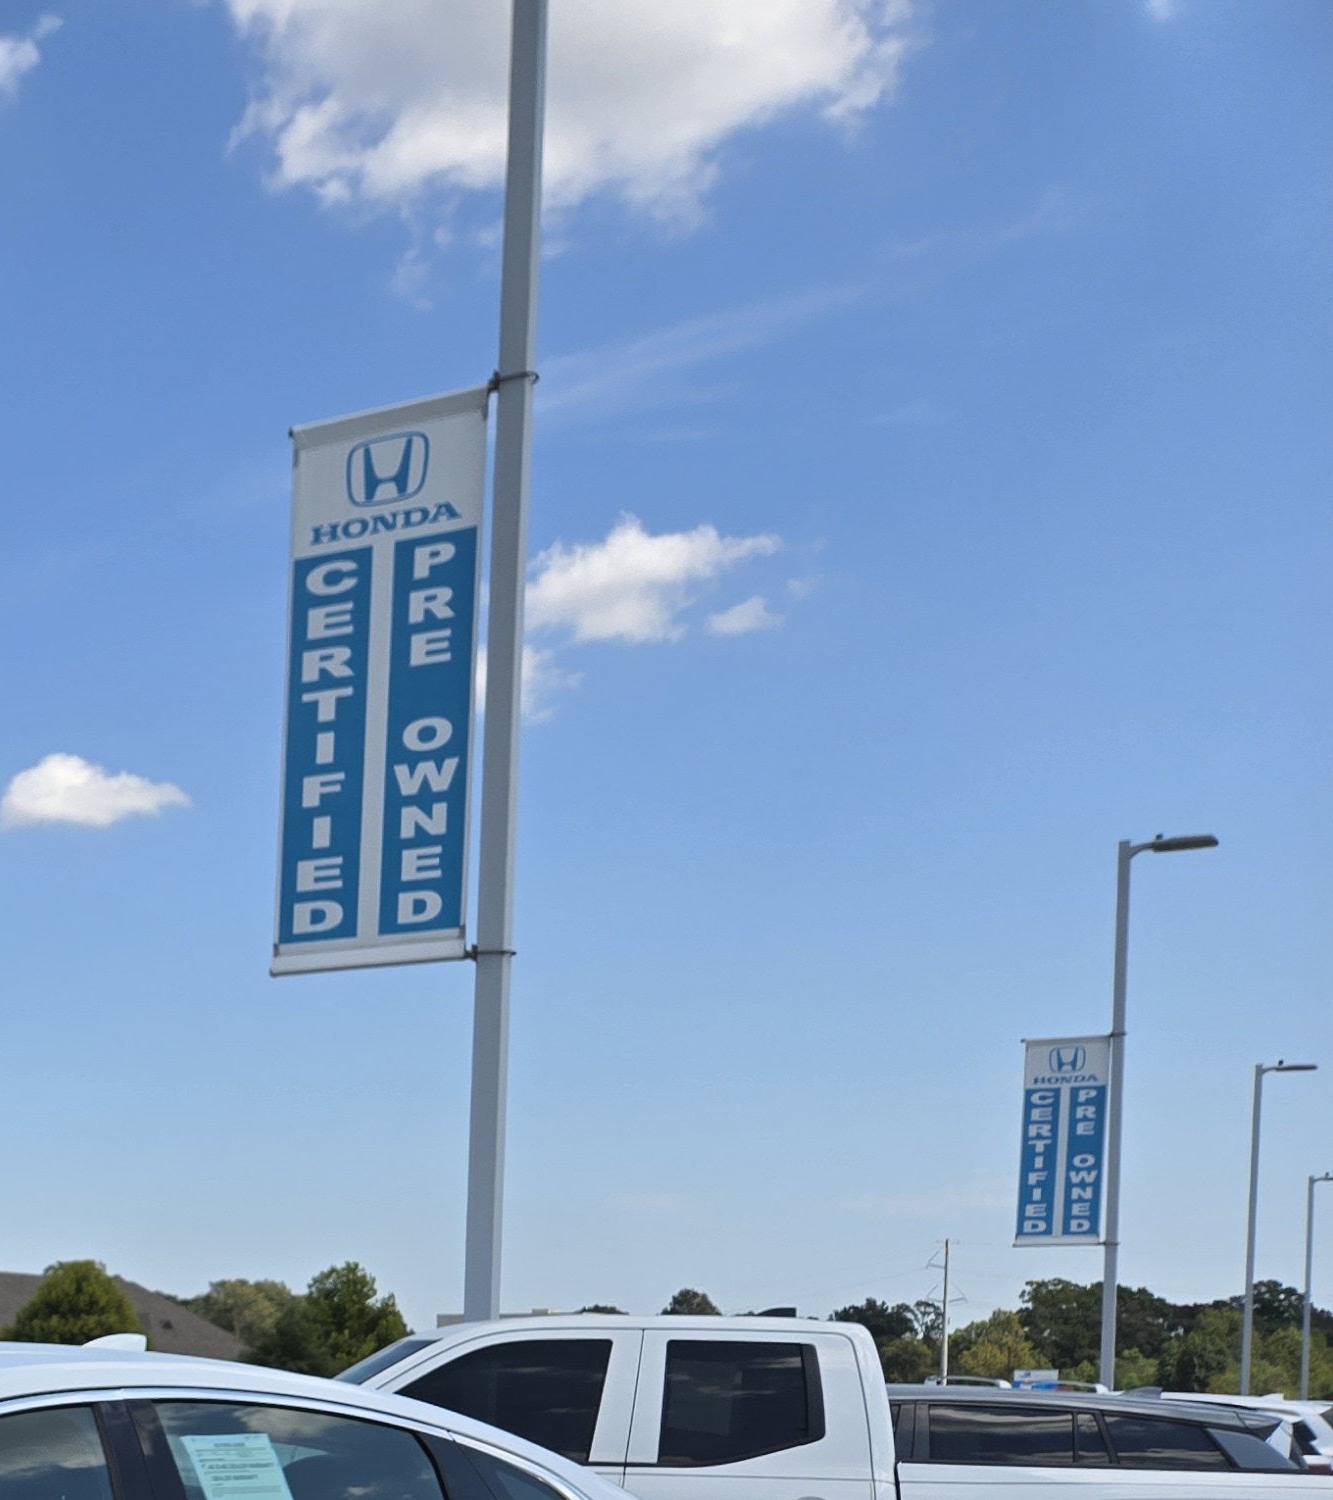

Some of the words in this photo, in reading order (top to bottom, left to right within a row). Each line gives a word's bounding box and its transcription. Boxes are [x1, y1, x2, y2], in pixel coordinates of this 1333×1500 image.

[310, 501, 462, 545] HONDA
[409, 541, 457, 668] PRE
[292, 559, 360, 936] CERTIFIED
[393, 715, 460, 925] OWNED
[1033, 1074, 1099, 1085] HONDA
[1075, 1089, 1098, 1135] PRE
[1023, 1091, 1055, 1233] CERTIFIED
[1069, 1154, 1098, 1233] OWNED
